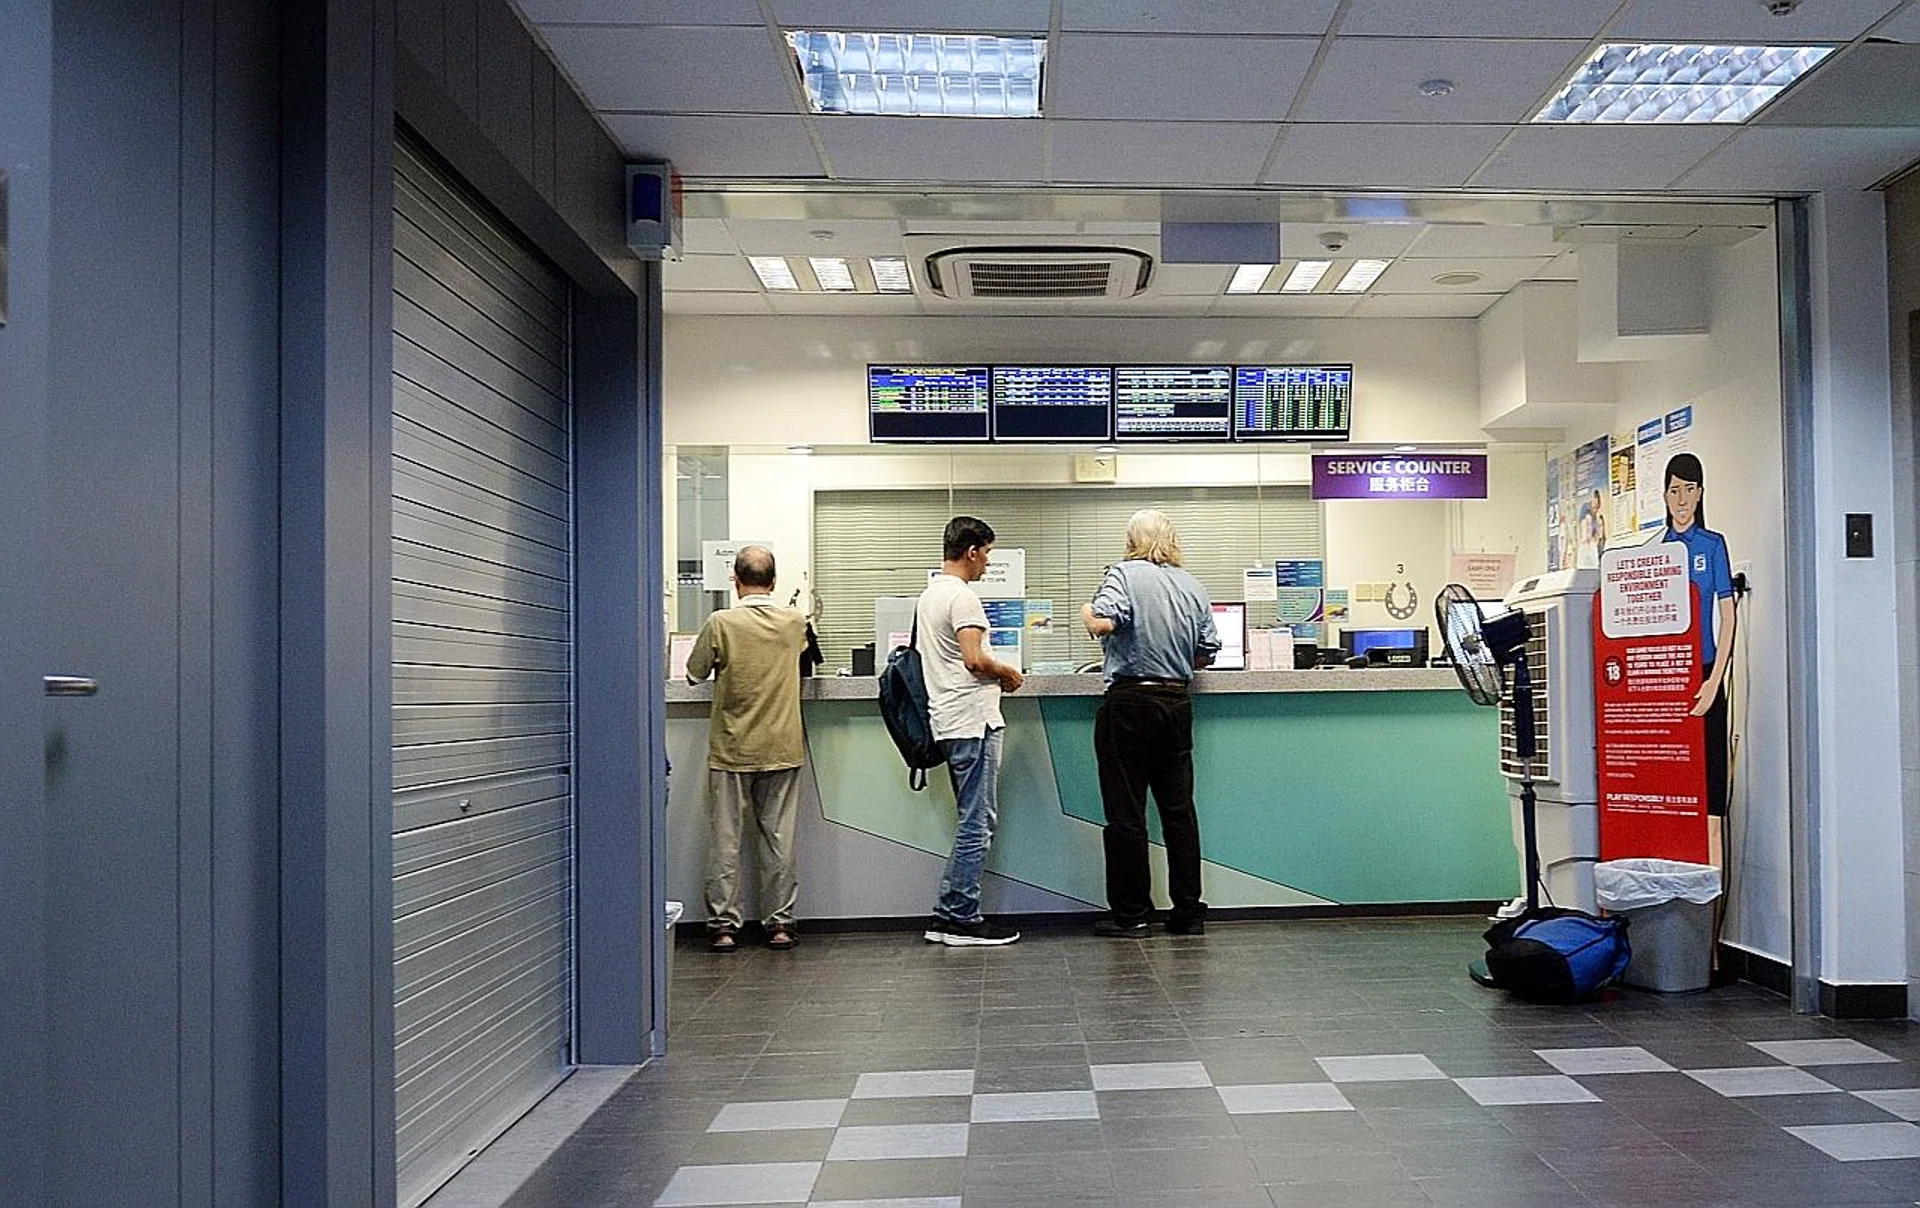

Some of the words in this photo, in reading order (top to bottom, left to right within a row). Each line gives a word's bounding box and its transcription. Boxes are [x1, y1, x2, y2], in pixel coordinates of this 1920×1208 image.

[1327, 461, 1392, 475] SERVICE
[1395, 461, 1471, 475] COUNTER
[1369, 477, 1431, 492] 服务柜台
[1396, 564, 1404, 574] 3
[1617, 560, 1635, 570] LET'S
[1638, 556, 1664, 568] CREATE
[1665, 556, 1671, 565] A
[1607, 569, 1652, 582] RESPONSIBLE
[1654, 566, 1682, 577] GAMING
[1620, 579, 1669, 593] ENVIRONMENT
[1627, 591, 1662, 604] TOGETHER
[1606, 665, 1621, 680] 18
